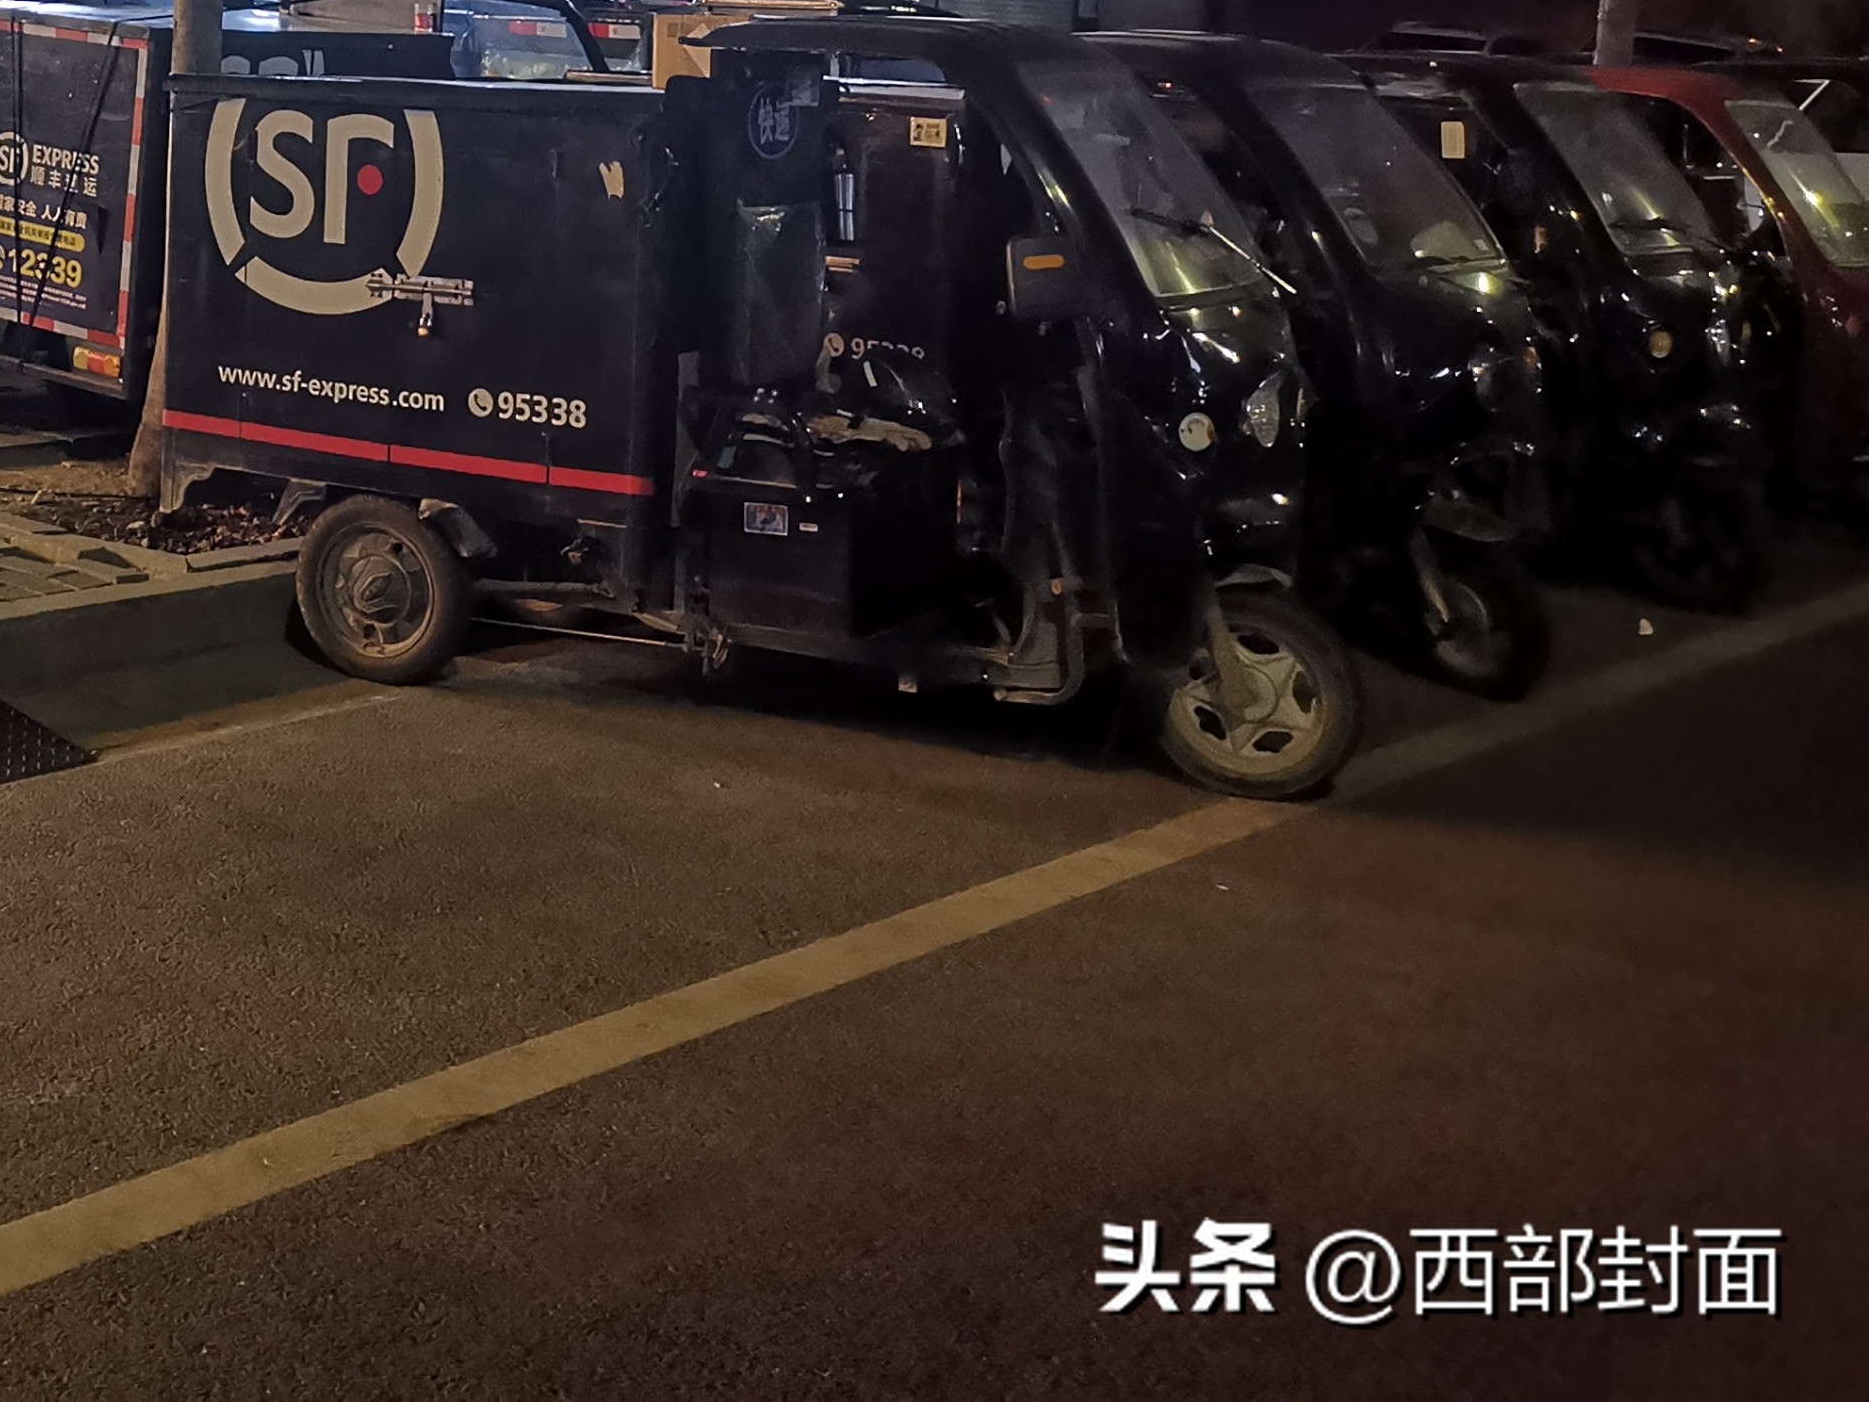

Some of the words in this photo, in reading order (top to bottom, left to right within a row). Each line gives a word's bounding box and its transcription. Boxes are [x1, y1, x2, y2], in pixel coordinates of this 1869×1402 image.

[32, 144, 100, 175] EXPRESS
[8, 248, 83, 289] 12339
[217, 364, 445, 412] www.sf-express.com
[497, 391, 587, 429] 95338
